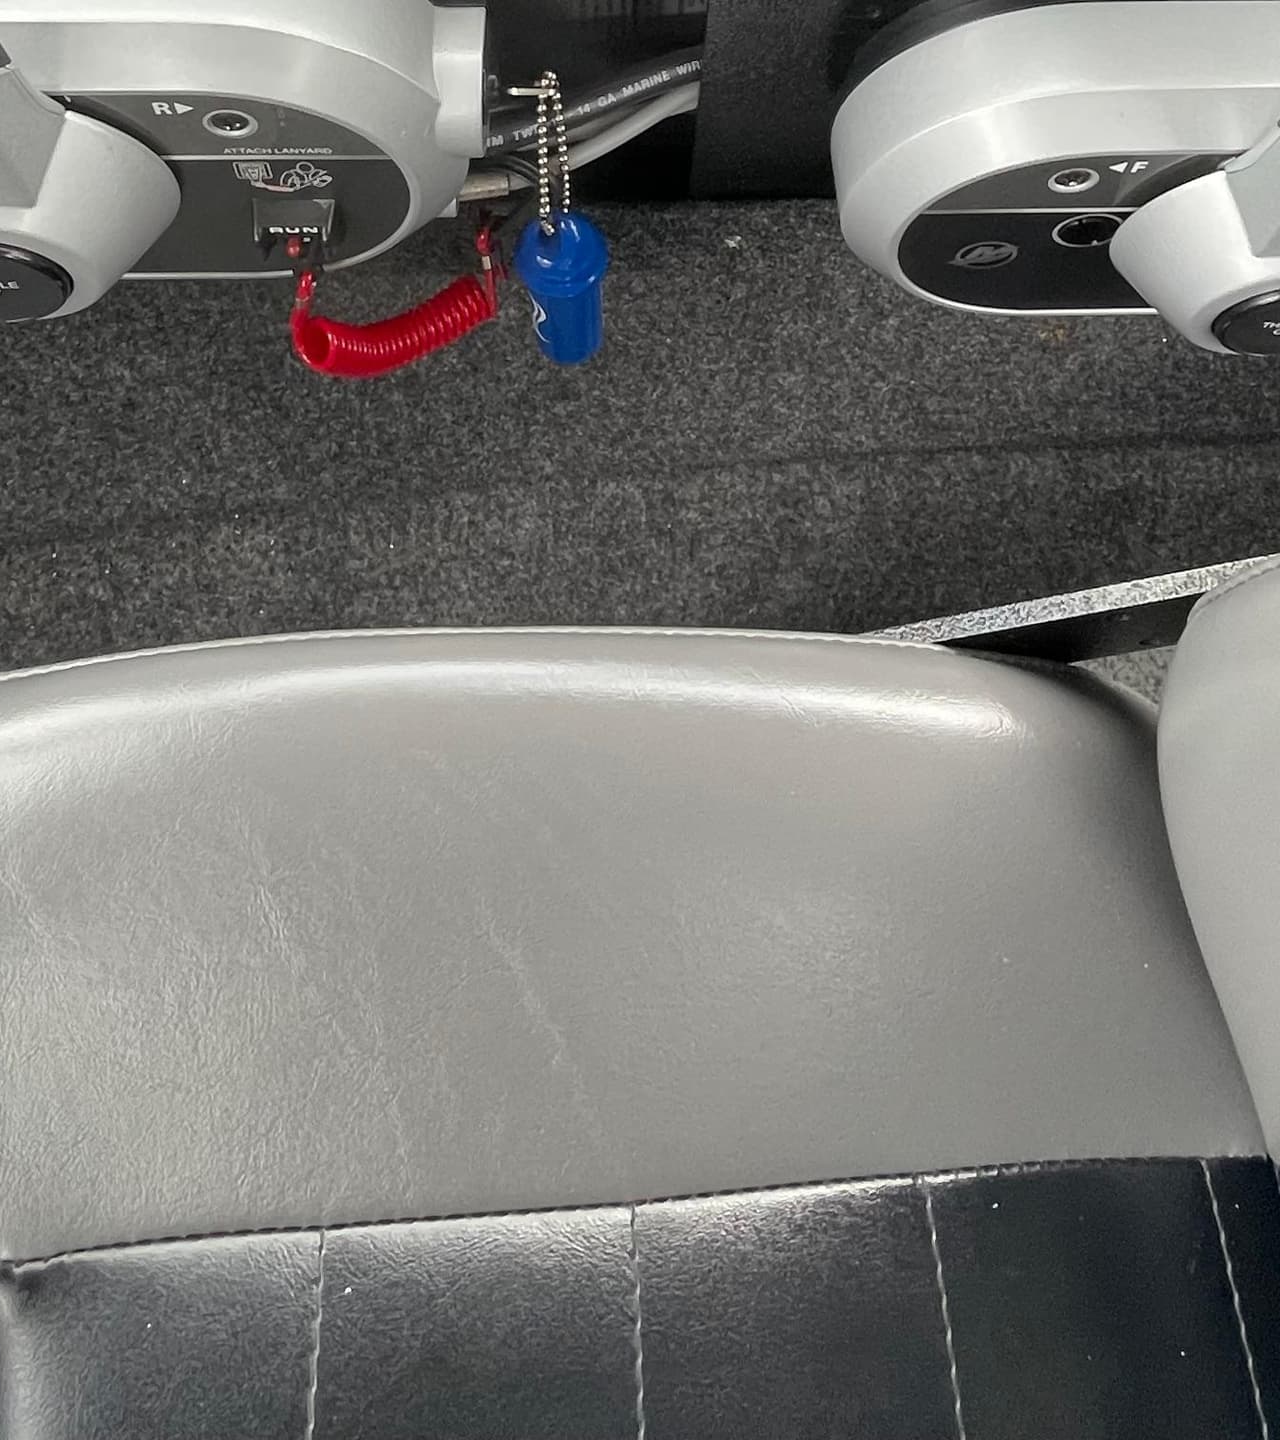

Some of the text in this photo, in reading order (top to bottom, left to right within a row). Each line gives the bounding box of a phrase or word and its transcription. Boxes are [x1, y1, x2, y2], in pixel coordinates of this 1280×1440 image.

[622, 70, 671, 97] MARINE
[151, 102, 172, 115] R
[274, 147, 333, 155] LANYARD
[1130, 161, 1149, 173] F
[269, 226, 319, 234] RUN
